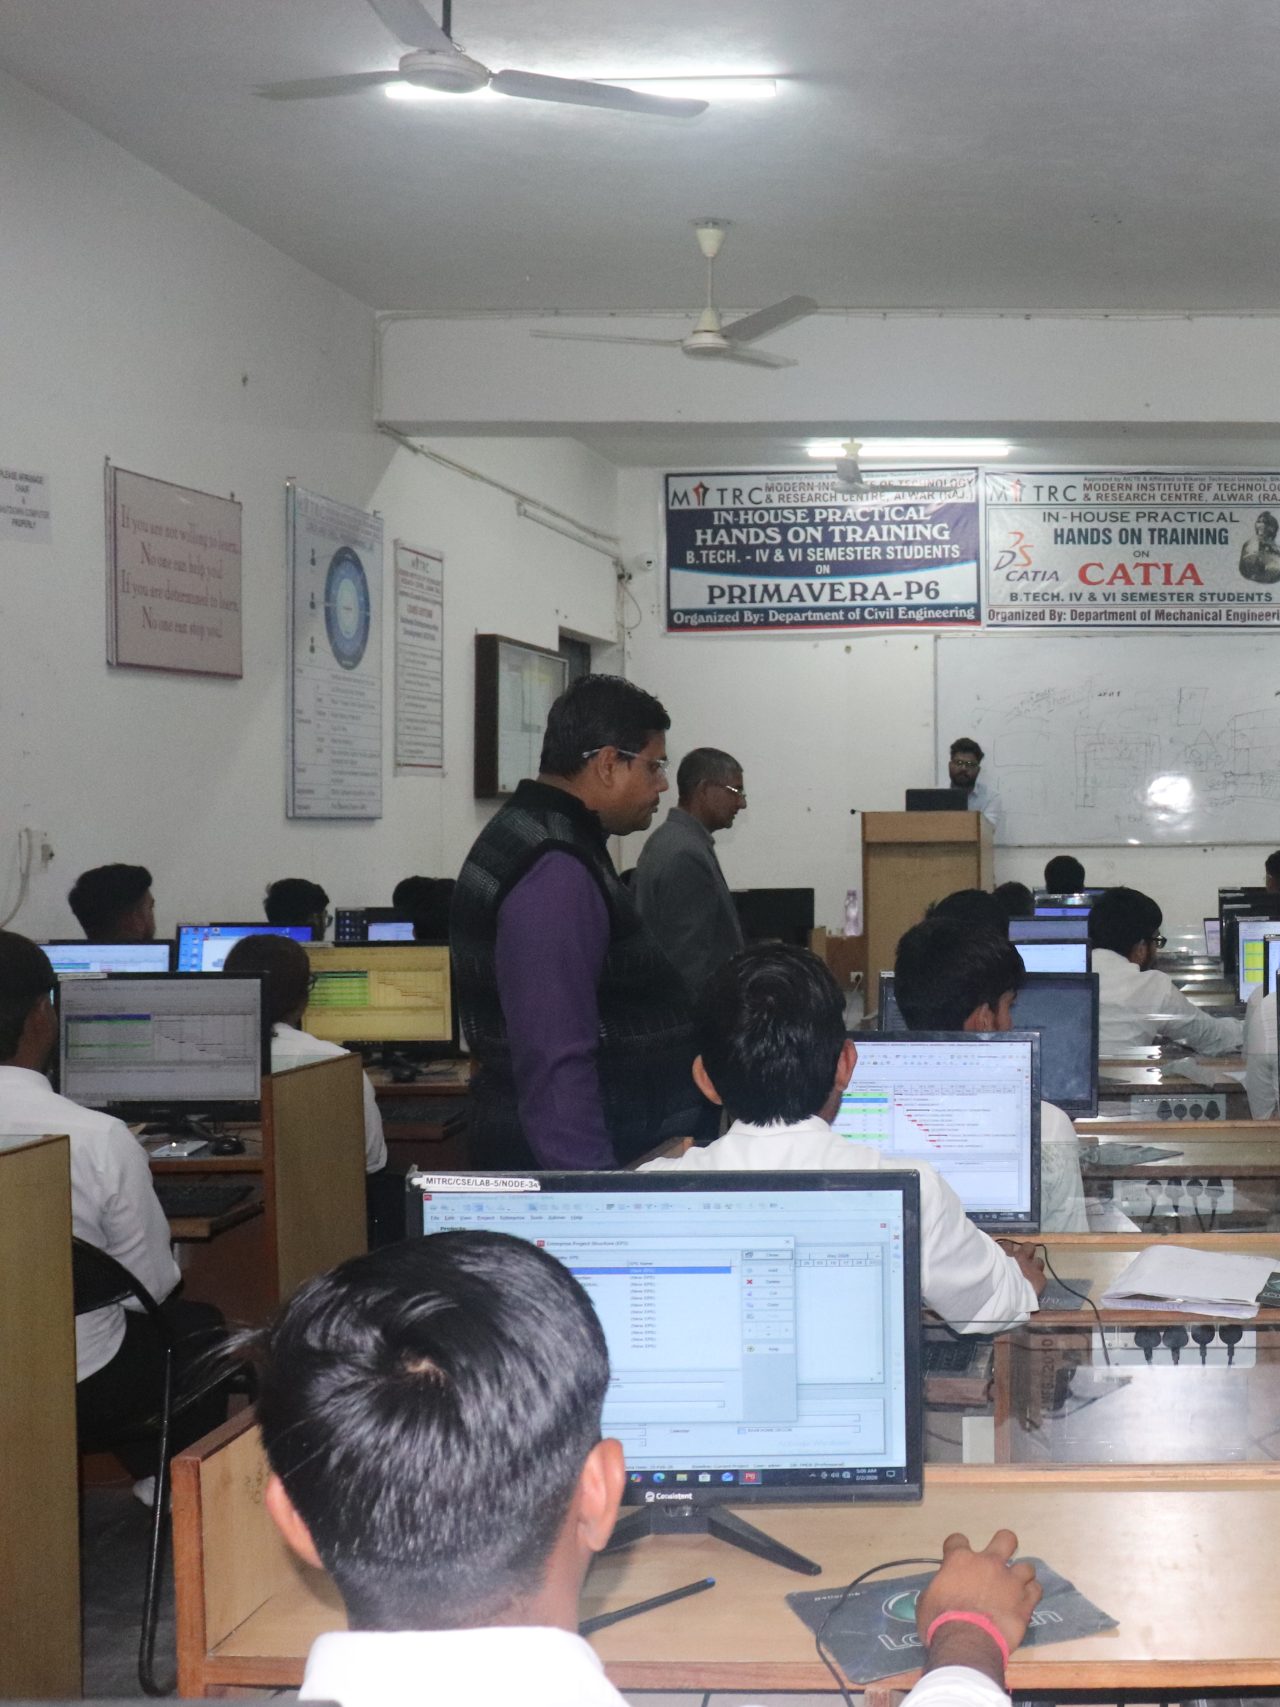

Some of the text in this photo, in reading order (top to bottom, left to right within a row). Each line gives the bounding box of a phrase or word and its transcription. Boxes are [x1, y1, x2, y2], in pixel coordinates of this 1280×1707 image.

[765, 482, 815, 492] MODERN
[1083, 483, 1135, 492] MODERN
[1137, 483, 1195, 492] INSTITUTE
[1198, 483, 1213, 492] OF
[766, 494, 773, 504] &
[778, 493, 836, 504] RESEARCH
[1083, 493, 1092, 502] &
[1096, 493, 1155, 502] RESEARCH
[1213, 493, 1253, 502] ALWAR
[713, 507, 931, 525] IN-HOUSE PRACTICAL
[1135, 511, 1240, 523] PRACTICAL
[695, 523, 951, 546] HANDS ON TRAINING
[1054, 528, 1229, 545] HANDS ON TRAINING
[686, 549, 741, 564] B.TECH.
[755, 549, 770, 562] IV
[774, 550, 785, 562] &
[789, 549, 802, 562] VI
[807, 548, 882, 561] SEMESTER
[885, 544, 960, 560] STUDENTS
[816, 564, 831, 575] ON
[1078, 563, 1204, 586] CATIA
[1005, 571, 1059, 582] CATIA
[707, 580, 940, 605] PRIMAVERA-P6
[1009, 592, 1273, 602] B.TECH. IV & VI SEMESTER STUDENTS
[673, 606, 976, 626] Organized By: Department of Civil Engineering
[988, 609, 1046, 624] Organized
[1049, 609, 1067, 623] By:
[1070, 608, 1136, 623] Department
[1140, 609, 1151, 621] of
[1155, 609, 1222, 621] Mechanical
[656, 1491, 693, 1500] Consistent
